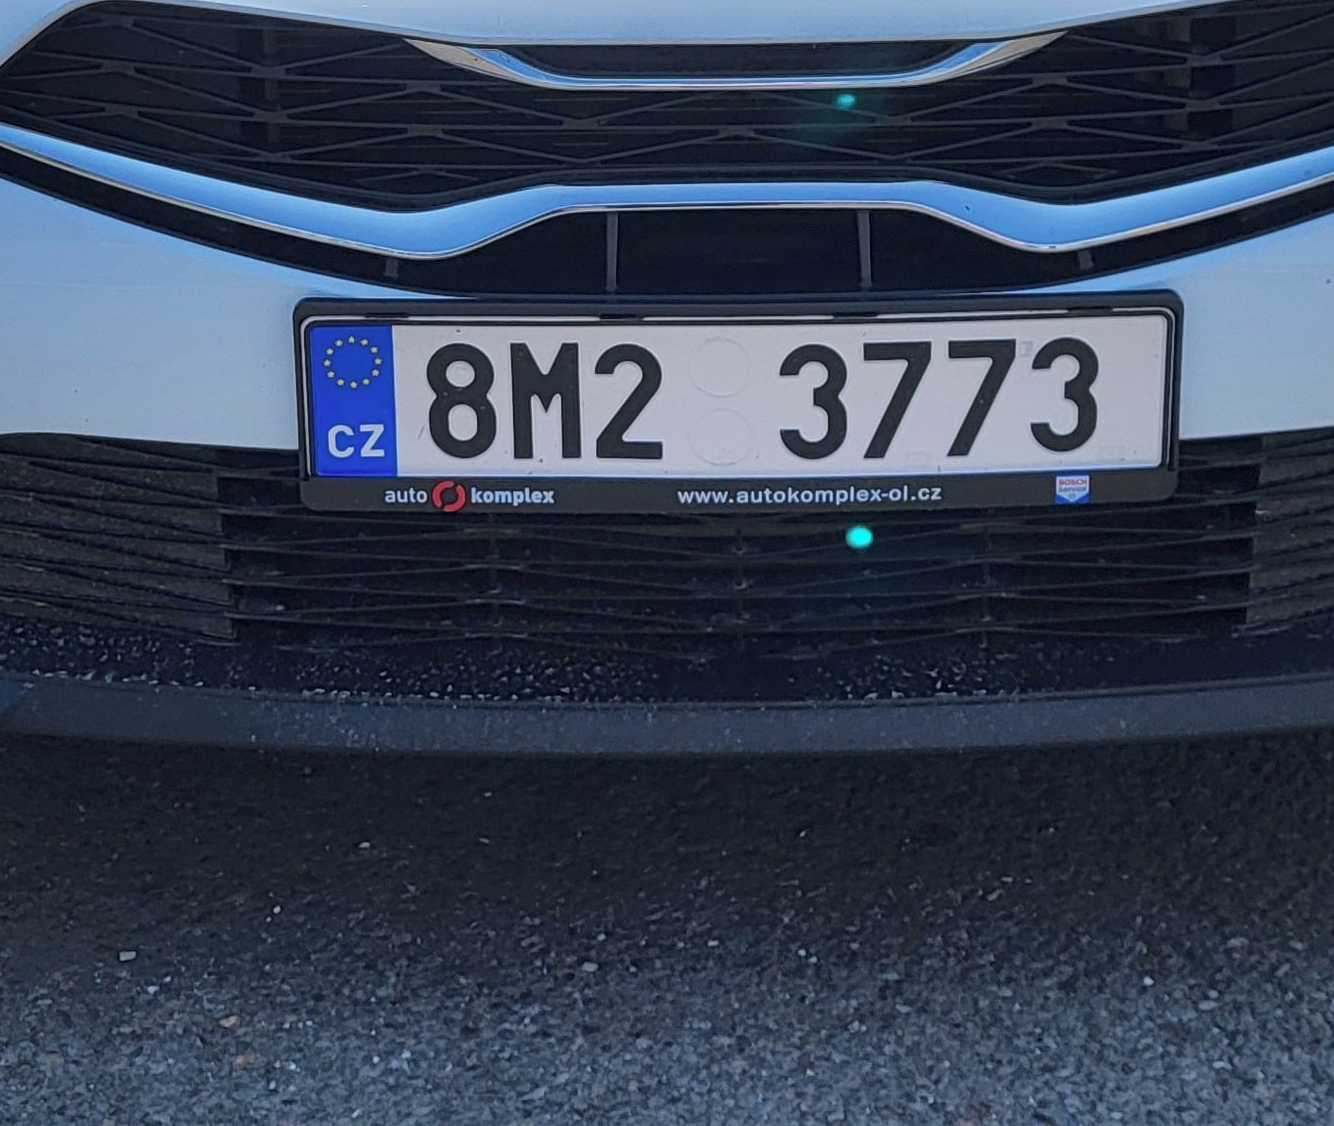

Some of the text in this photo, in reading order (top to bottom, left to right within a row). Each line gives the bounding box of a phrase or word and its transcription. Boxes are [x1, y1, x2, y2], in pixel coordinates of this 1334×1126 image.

[426, 337, 1099, 459] 8M2 3773
[328, 424, 385, 458] CZ
[384, 486, 555, 506] auto komplex
[677, 485, 942, 506] www.autokomplex-ol.cz
